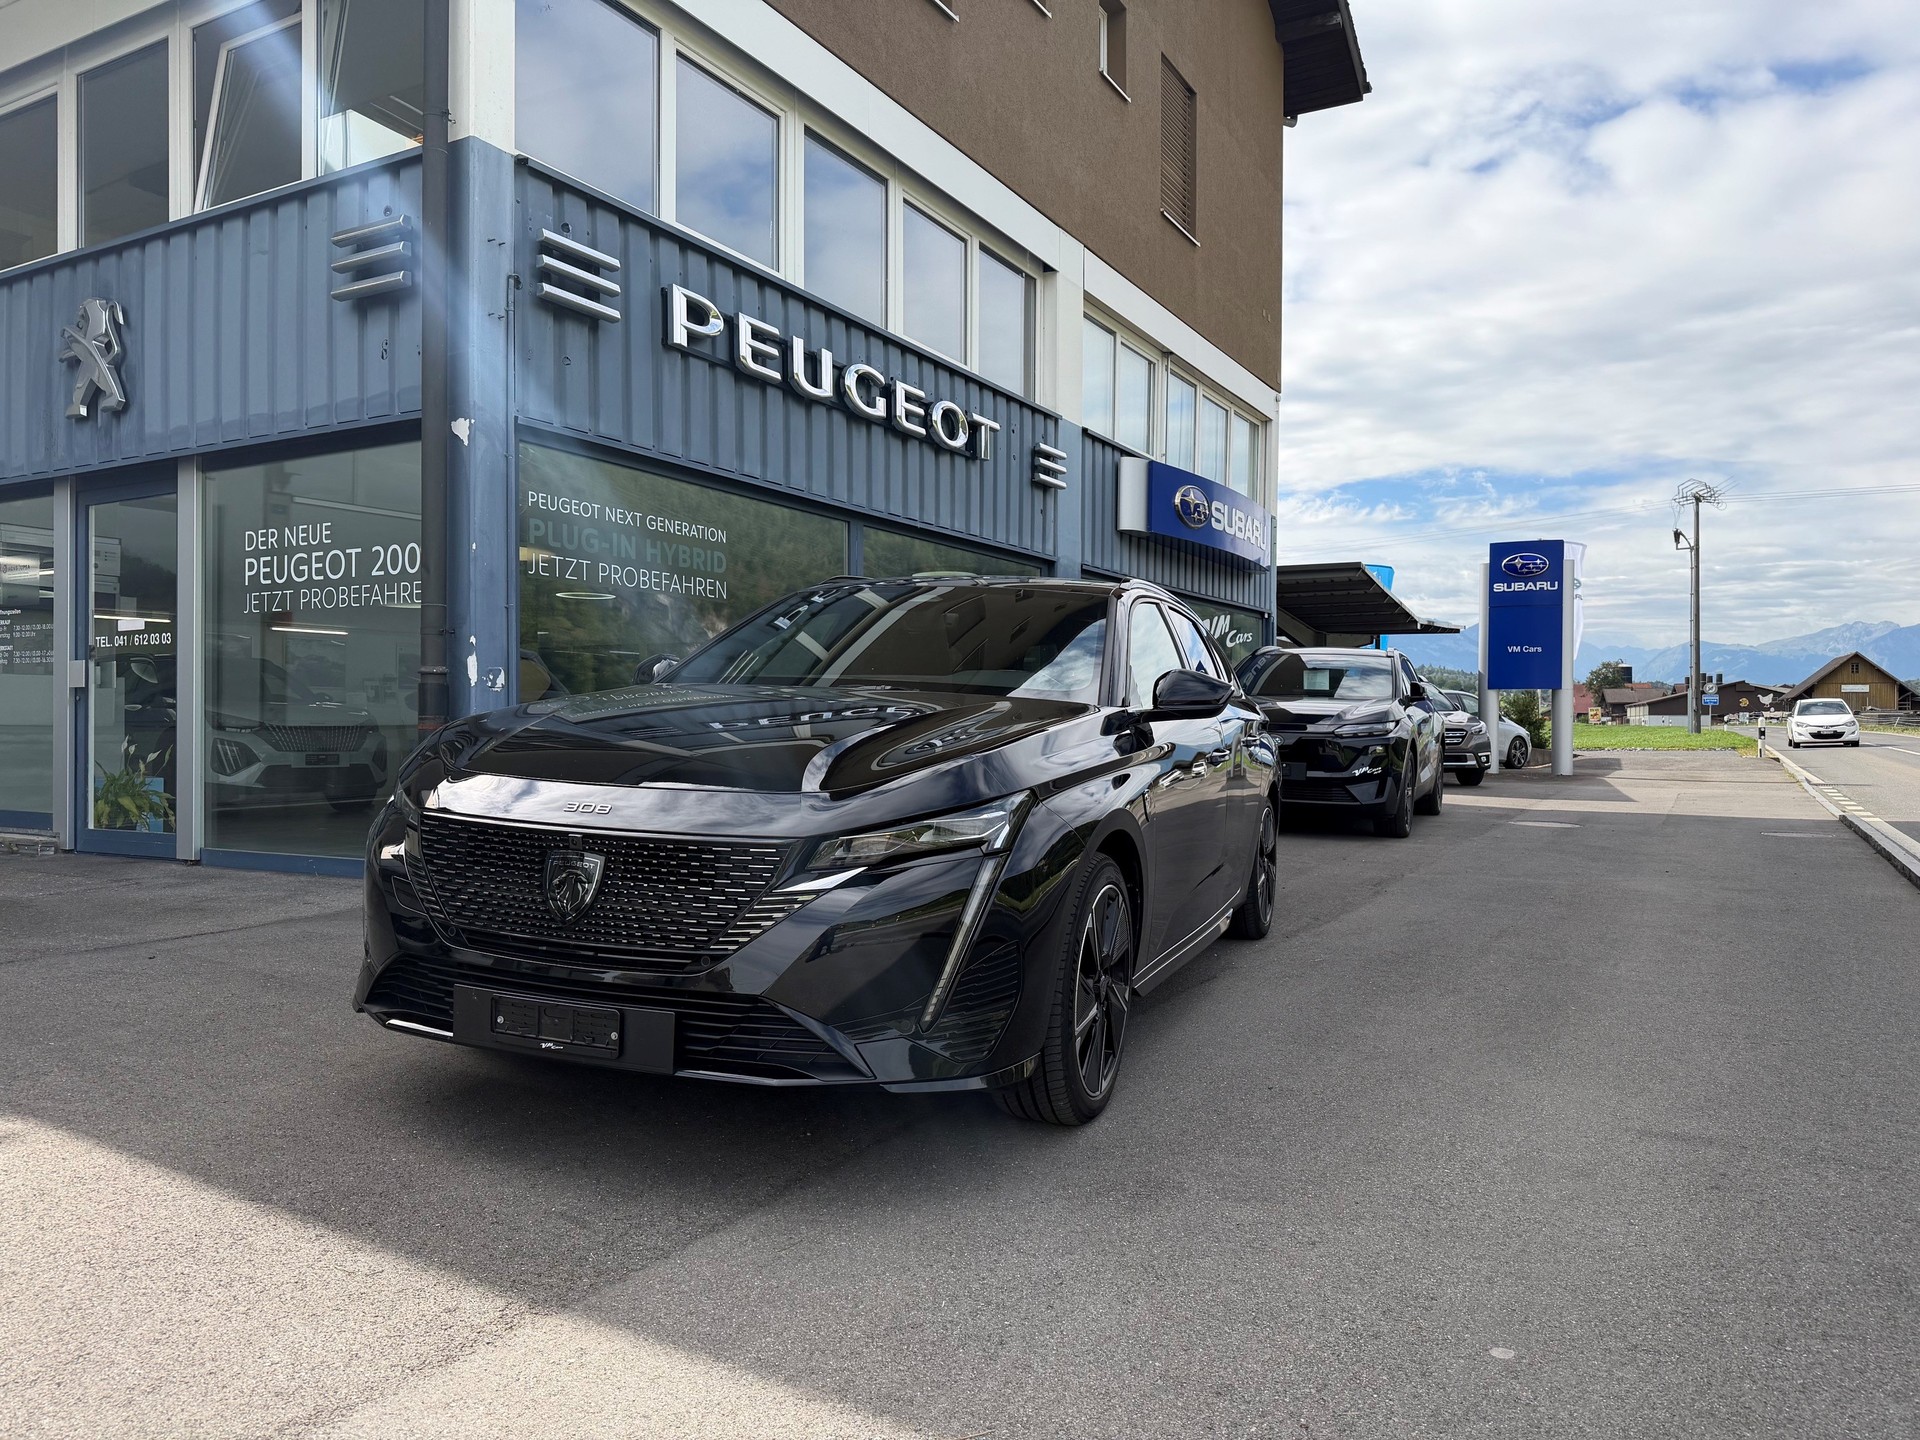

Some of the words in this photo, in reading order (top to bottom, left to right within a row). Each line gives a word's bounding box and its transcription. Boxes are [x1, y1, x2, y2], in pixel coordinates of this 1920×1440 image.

[664, 283, 1001, 461] PEUGEOT
[528, 490, 601, 519] PEUGEOT
[605, 506, 643, 527] NEXT
[646, 515, 727, 543] GENERATION
[1211, 500, 1268, 551] SUBARU
[244, 528, 278, 551] DER
[284, 522, 332, 548] NEUE
[528, 517, 636, 560] PLUG-IN
[646, 538, 727, 574] HYBRID
[244, 547, 362, 586] PEUGEOT
[371, 542, 422, 576] 200
[528, 552, 592, 581] JETZT
[598, 562, 727, 600] PROBEFAHREN
[243, 589, 294, 614] JETZT
[300, 580, 422, 610] PROBEFAHRE
[1493, 581, 1559, 592] SUBARU
[95, 636, 113, 648] TEL.
[114, 635, 128, 647] 041
[134, 633, 149, 646] 612
[150, 633, 160, 645] 03
[161, 632, 172, 644] 03
[1225, 629, 1253, 648] Cars
[1507, 645, 1521, 653] VM
[1522, 645, 1543, 653] Cars
[563, 801, 613, 814] 308
[552, 860, 596, 869] PEUGEOT
